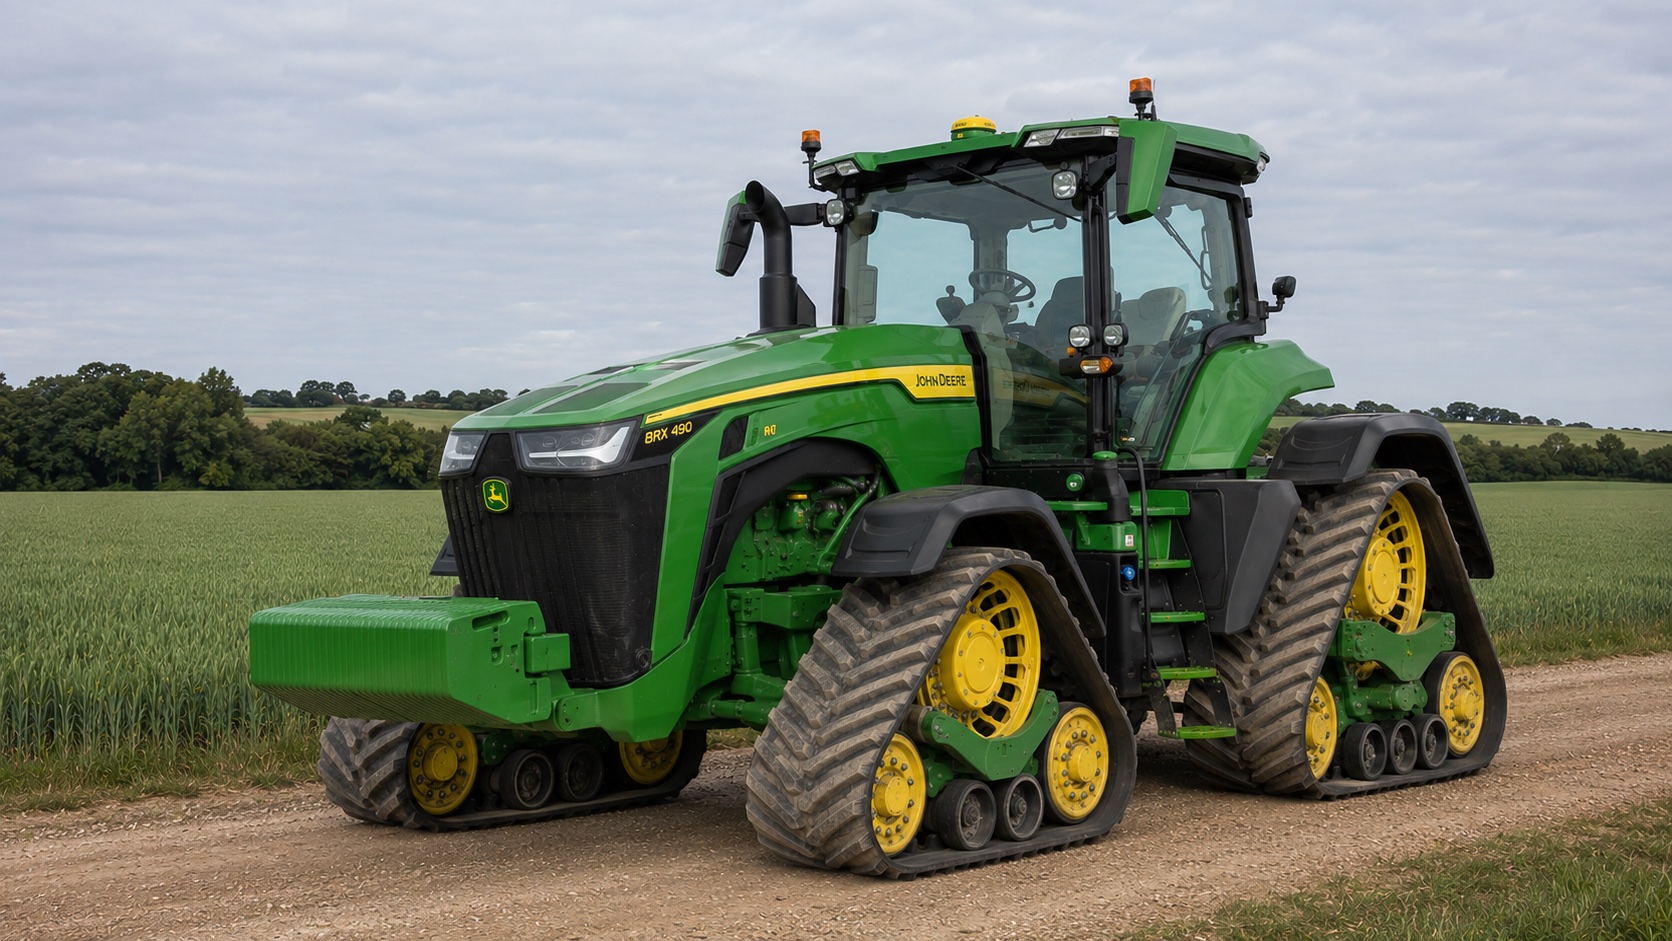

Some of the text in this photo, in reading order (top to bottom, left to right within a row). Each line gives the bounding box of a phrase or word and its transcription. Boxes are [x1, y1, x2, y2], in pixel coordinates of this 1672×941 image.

[916, 373, 966, 387] JOHN DEERE
[645, 421, 692, 444] BRX 490
